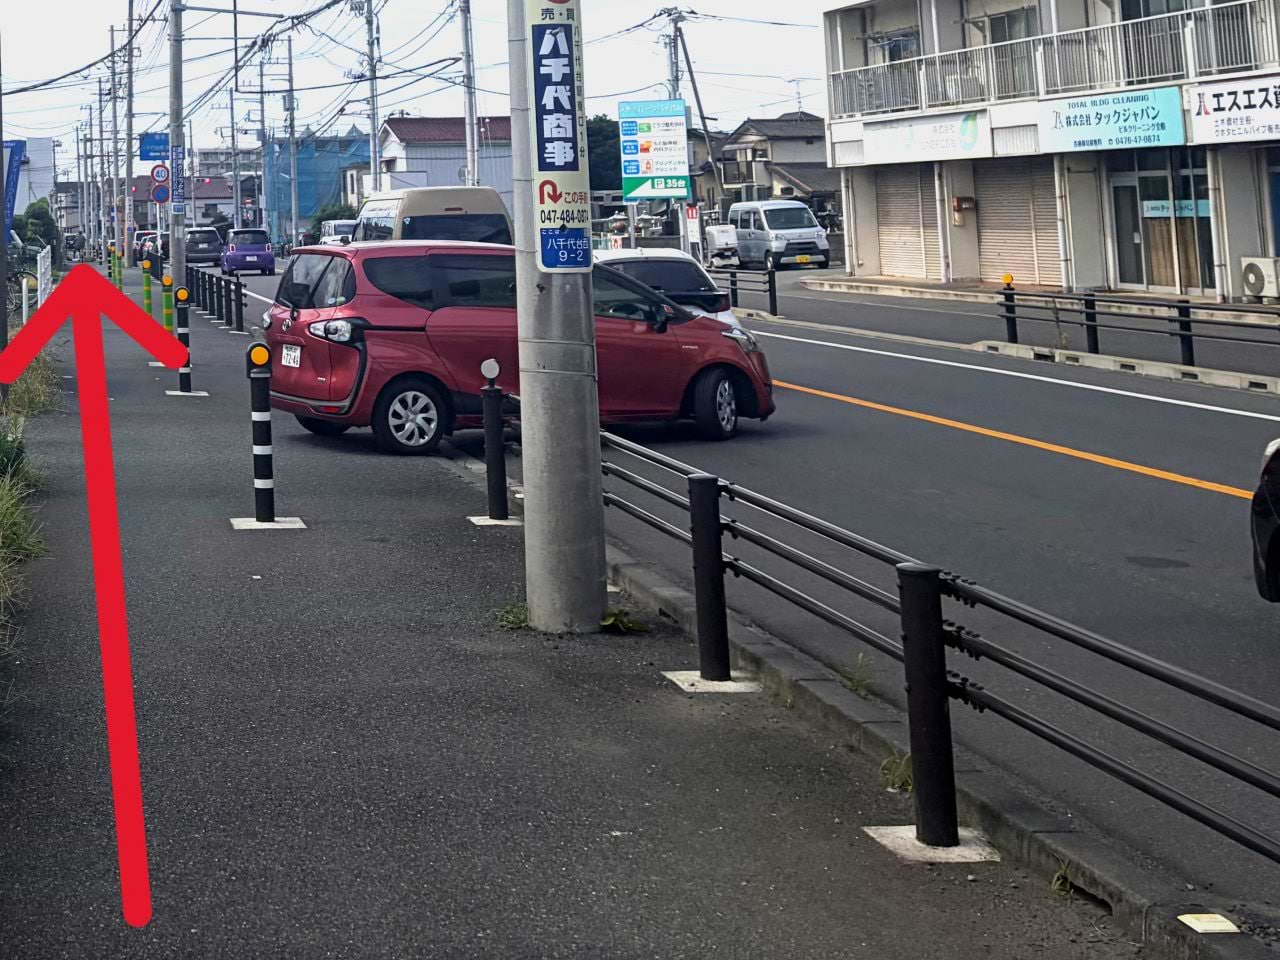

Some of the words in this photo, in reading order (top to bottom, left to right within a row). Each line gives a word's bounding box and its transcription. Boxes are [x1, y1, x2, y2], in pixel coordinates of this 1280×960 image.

[538, 26, 575, 166] 八千代商事
[1112, 94, 1150, 105] CLEANING
[1065, 114, 1092, 128] 株式会社
[1094, 106, 1161, 126] タックジャパン
[155, 169, 166, 179] 40
[559, 249, 584, 262] 9-2
